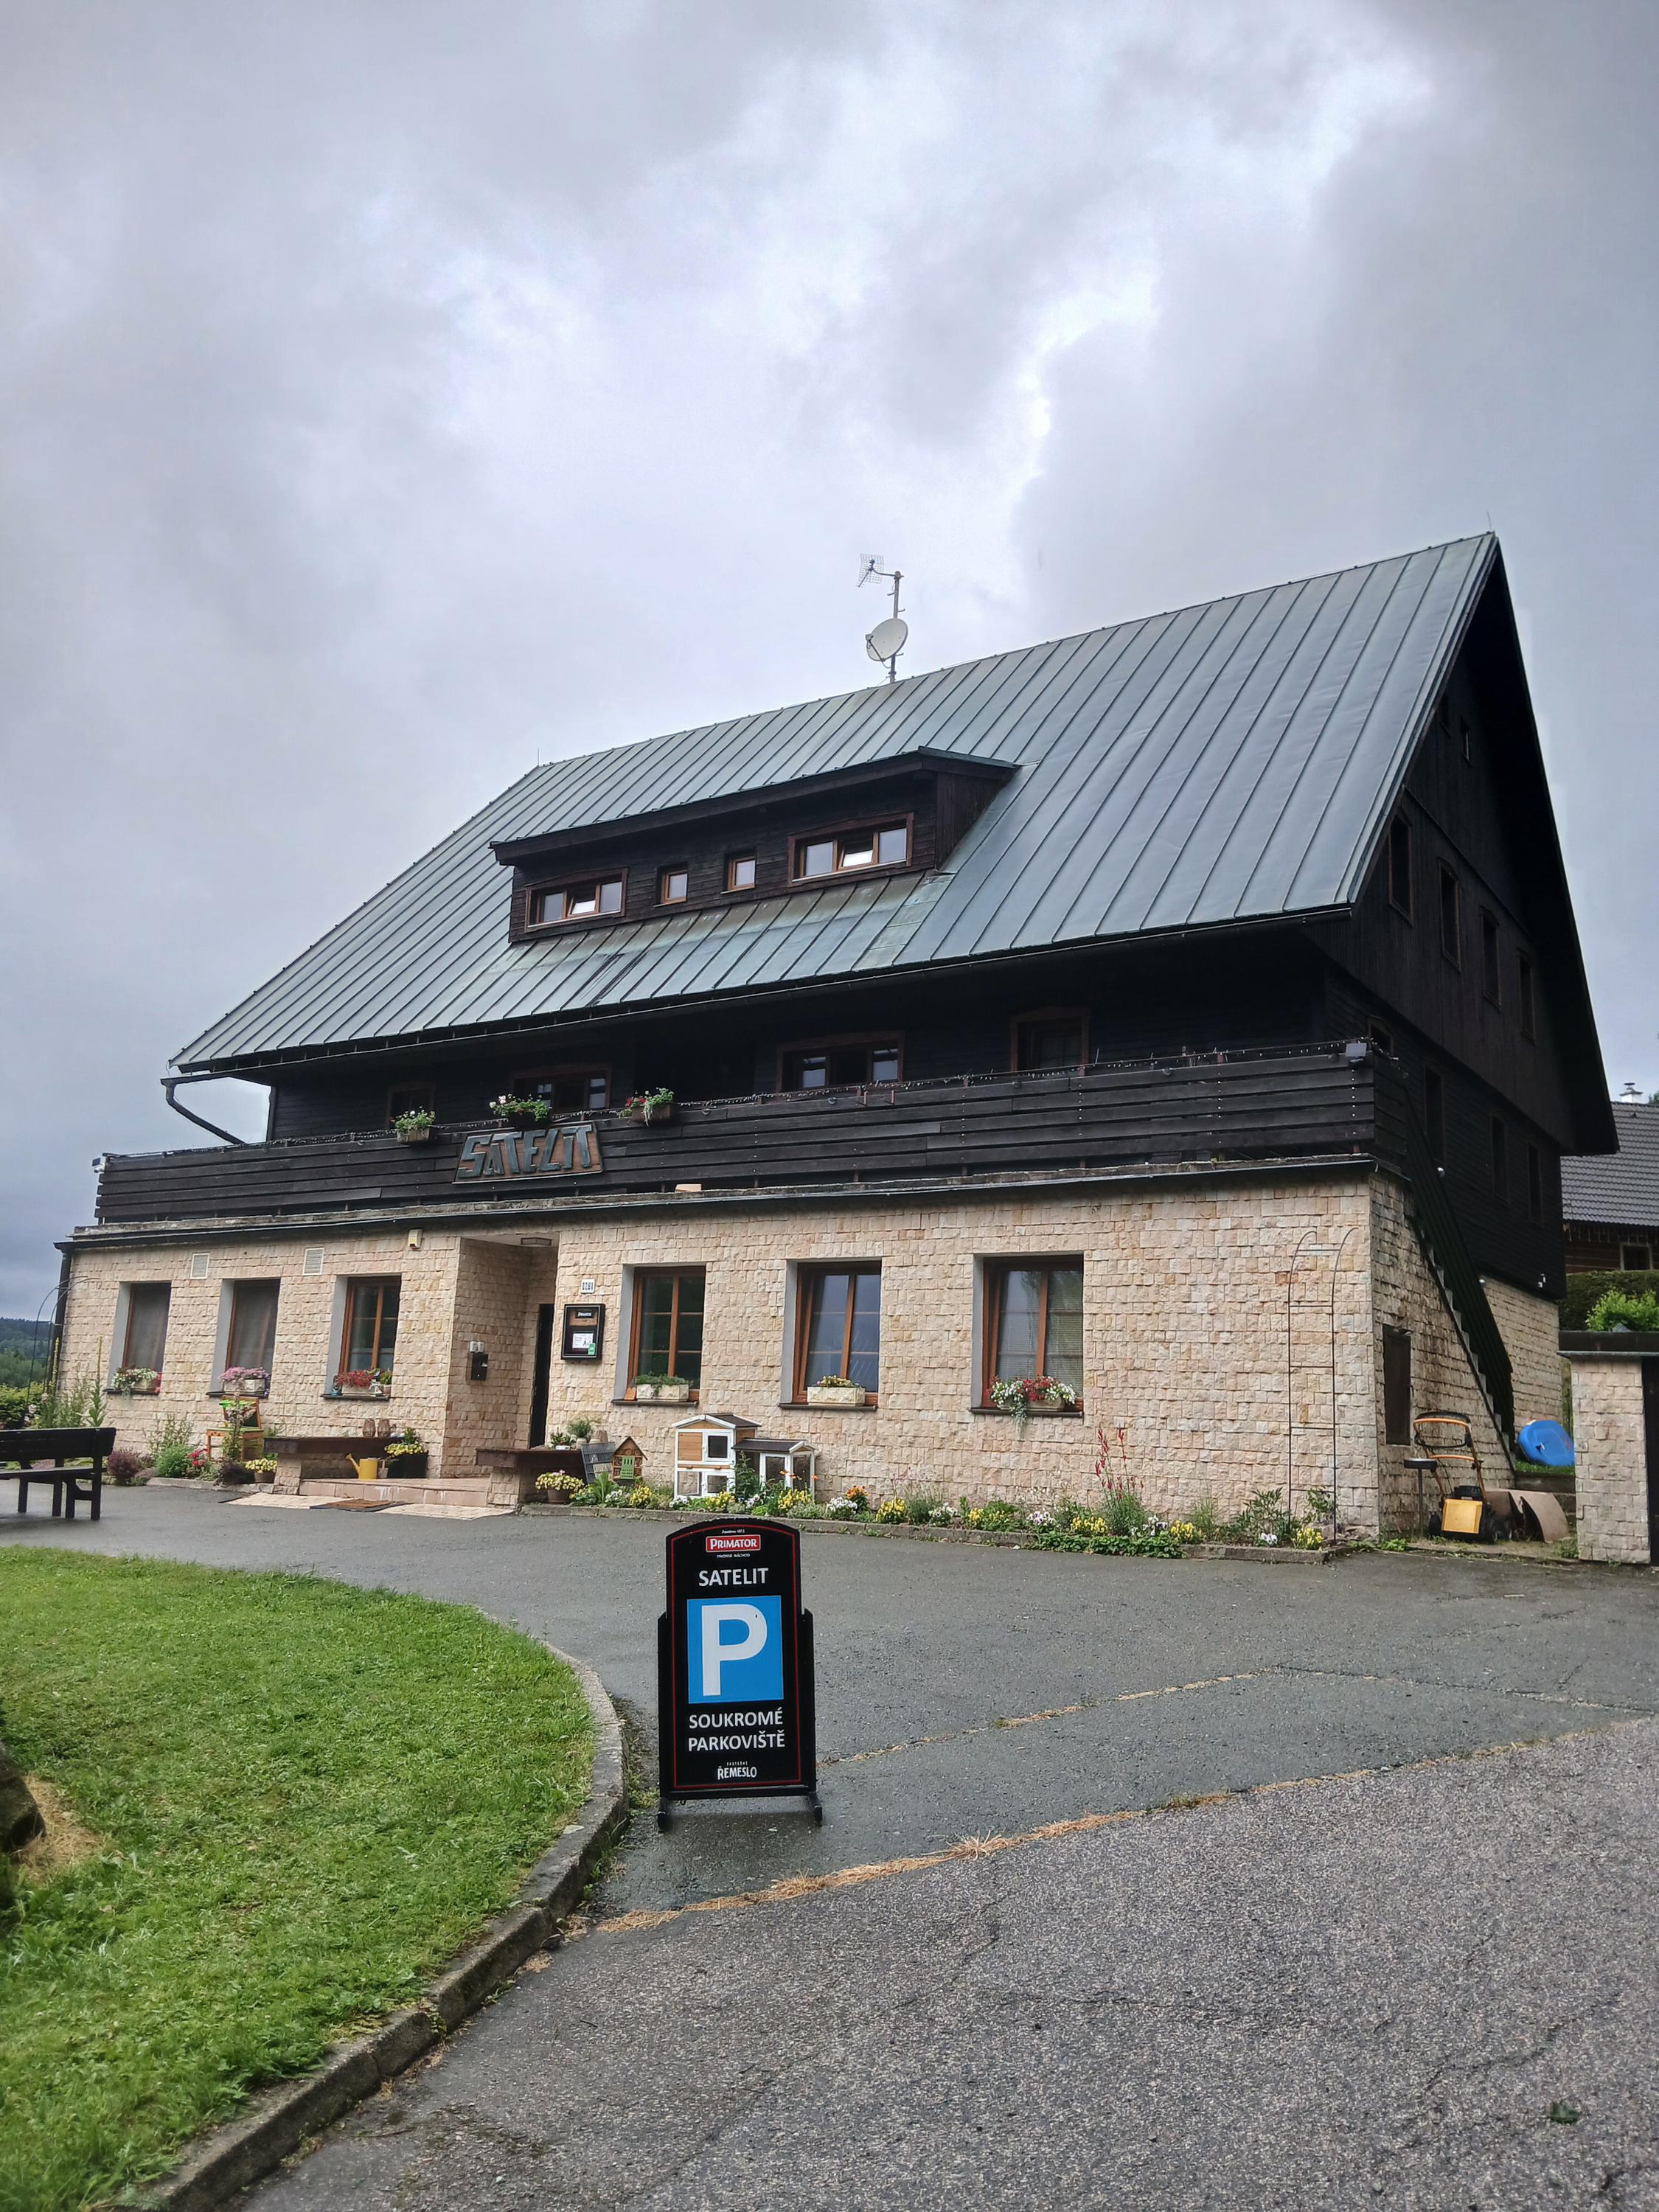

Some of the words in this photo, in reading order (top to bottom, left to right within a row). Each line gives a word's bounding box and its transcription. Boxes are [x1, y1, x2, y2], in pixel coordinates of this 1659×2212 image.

[458, 1125, 592, 1178] SATELIT
[698, 1568, 768, 1586] SATELIT
[701, 1604, 768, 1696] P
[689, 1707, 784, 1729] SOUKROMÉ
[688, 1729, 785, 1751] PARKOVIŠTĚ
[717, 1765, 757, 1781] ŘEMESLO
